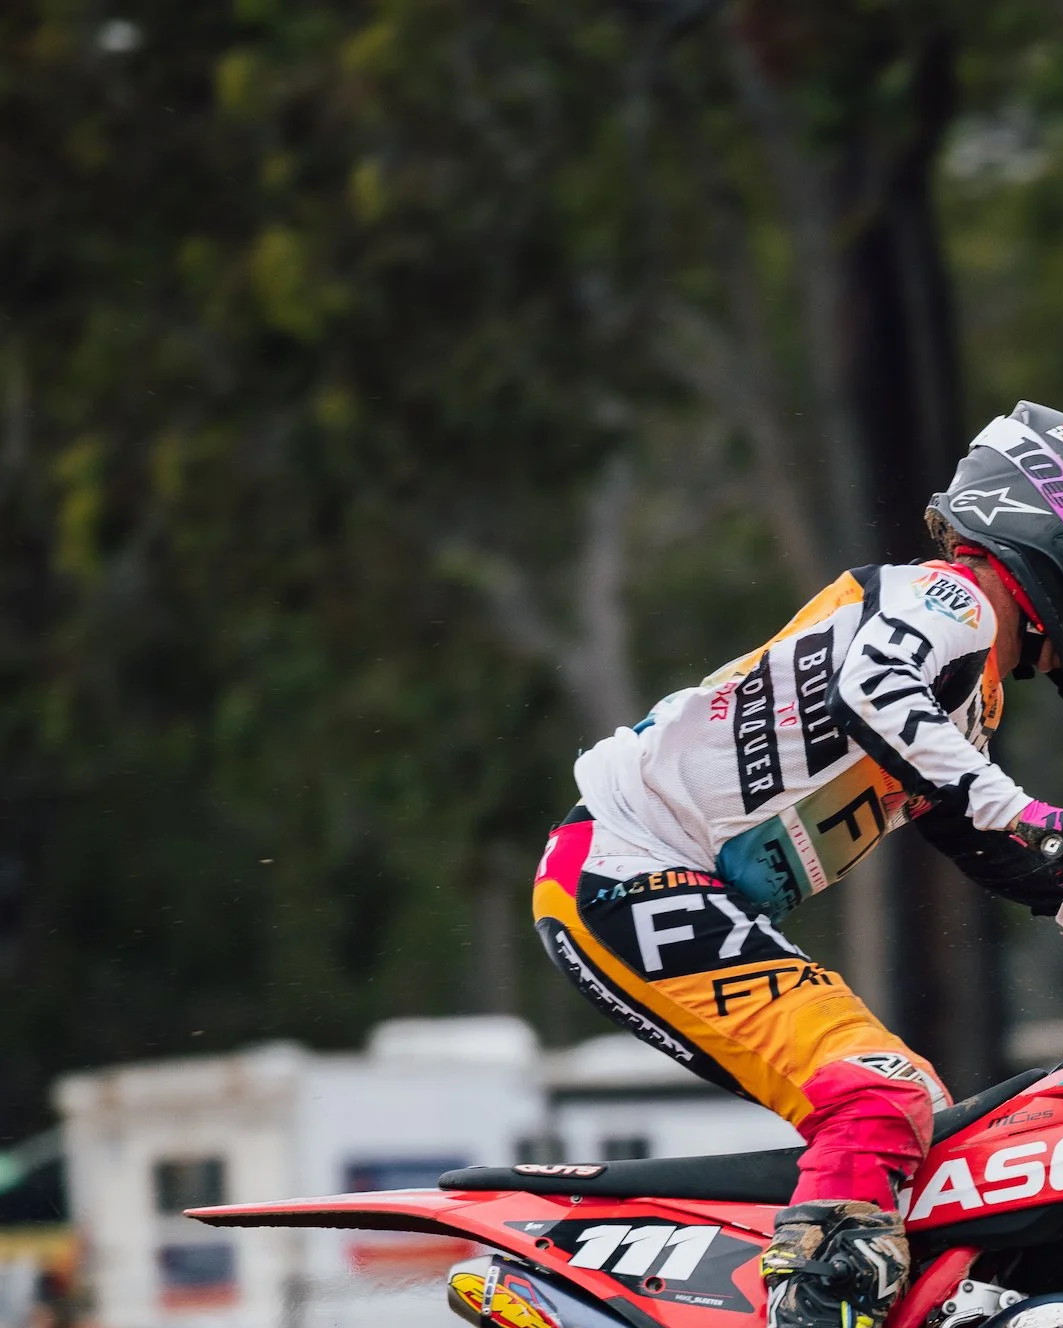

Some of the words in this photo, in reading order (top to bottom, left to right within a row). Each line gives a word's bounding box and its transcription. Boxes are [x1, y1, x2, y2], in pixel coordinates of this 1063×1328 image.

[925, 585, 970, 611] DIV
[935, 578, 975, 606] RACE
[777, 701, 797, 727] TO
[798, 647, 840, 745] BUILT
[738, 677, 775, 795] ONQUER
[631, 892, 811, 973] FX
[567, 1224, 722, 1282] 111
